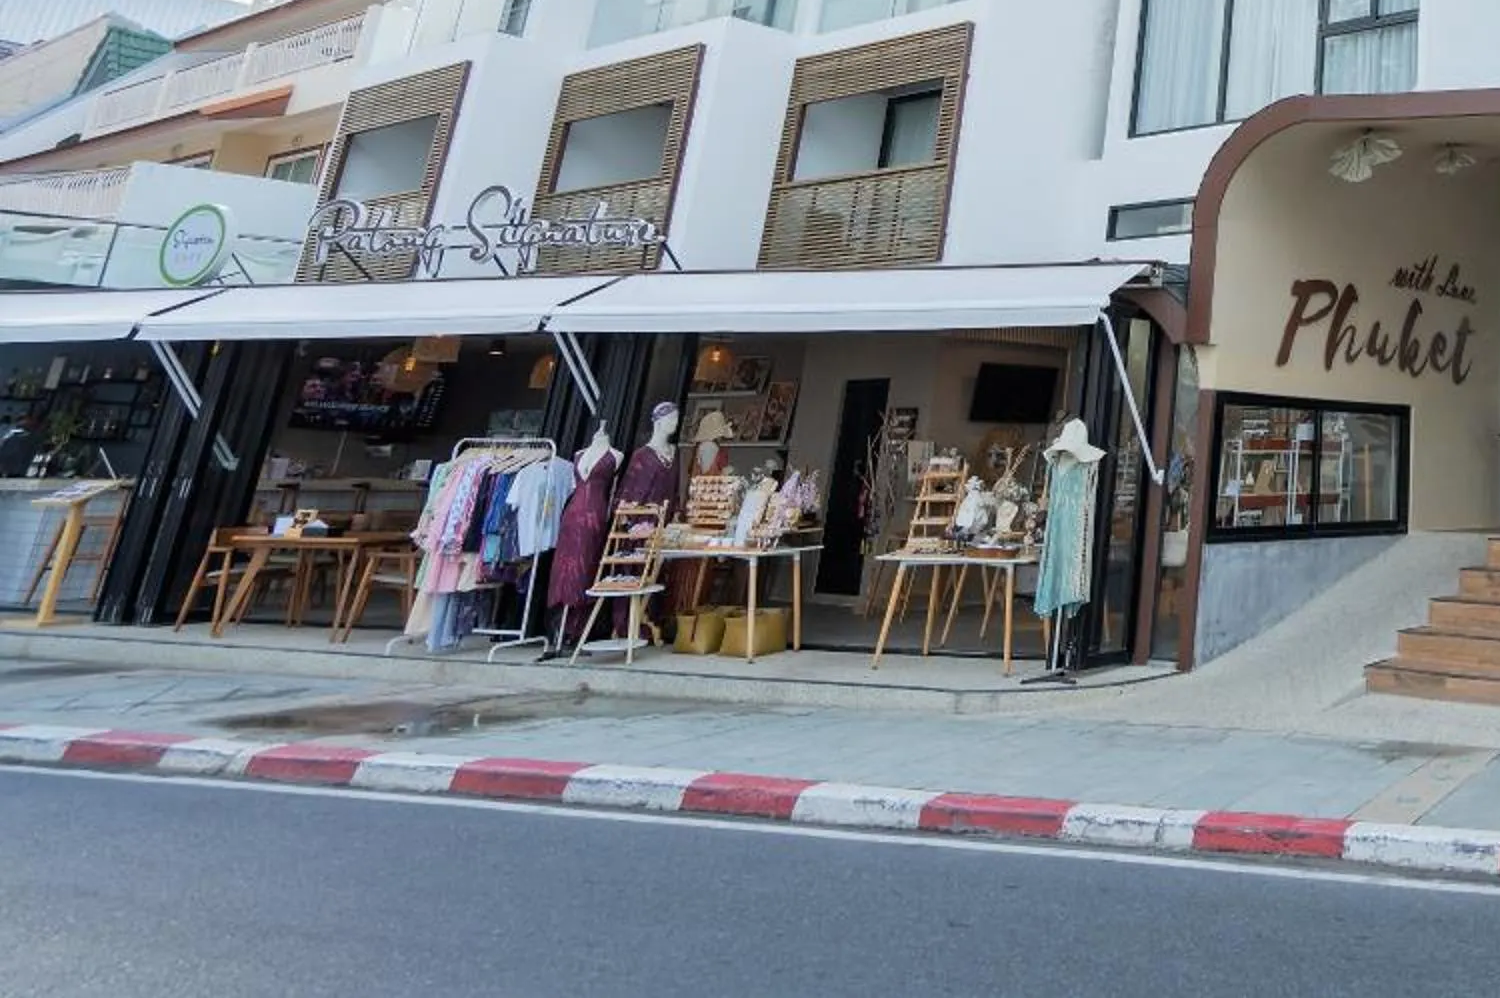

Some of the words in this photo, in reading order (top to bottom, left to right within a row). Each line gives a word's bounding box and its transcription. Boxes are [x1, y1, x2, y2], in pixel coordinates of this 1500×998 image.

[308, 198, 446, 273] Patong
[466, 184, 660, 271] Signature
[1275, 278, 1478, 385] Phuket
